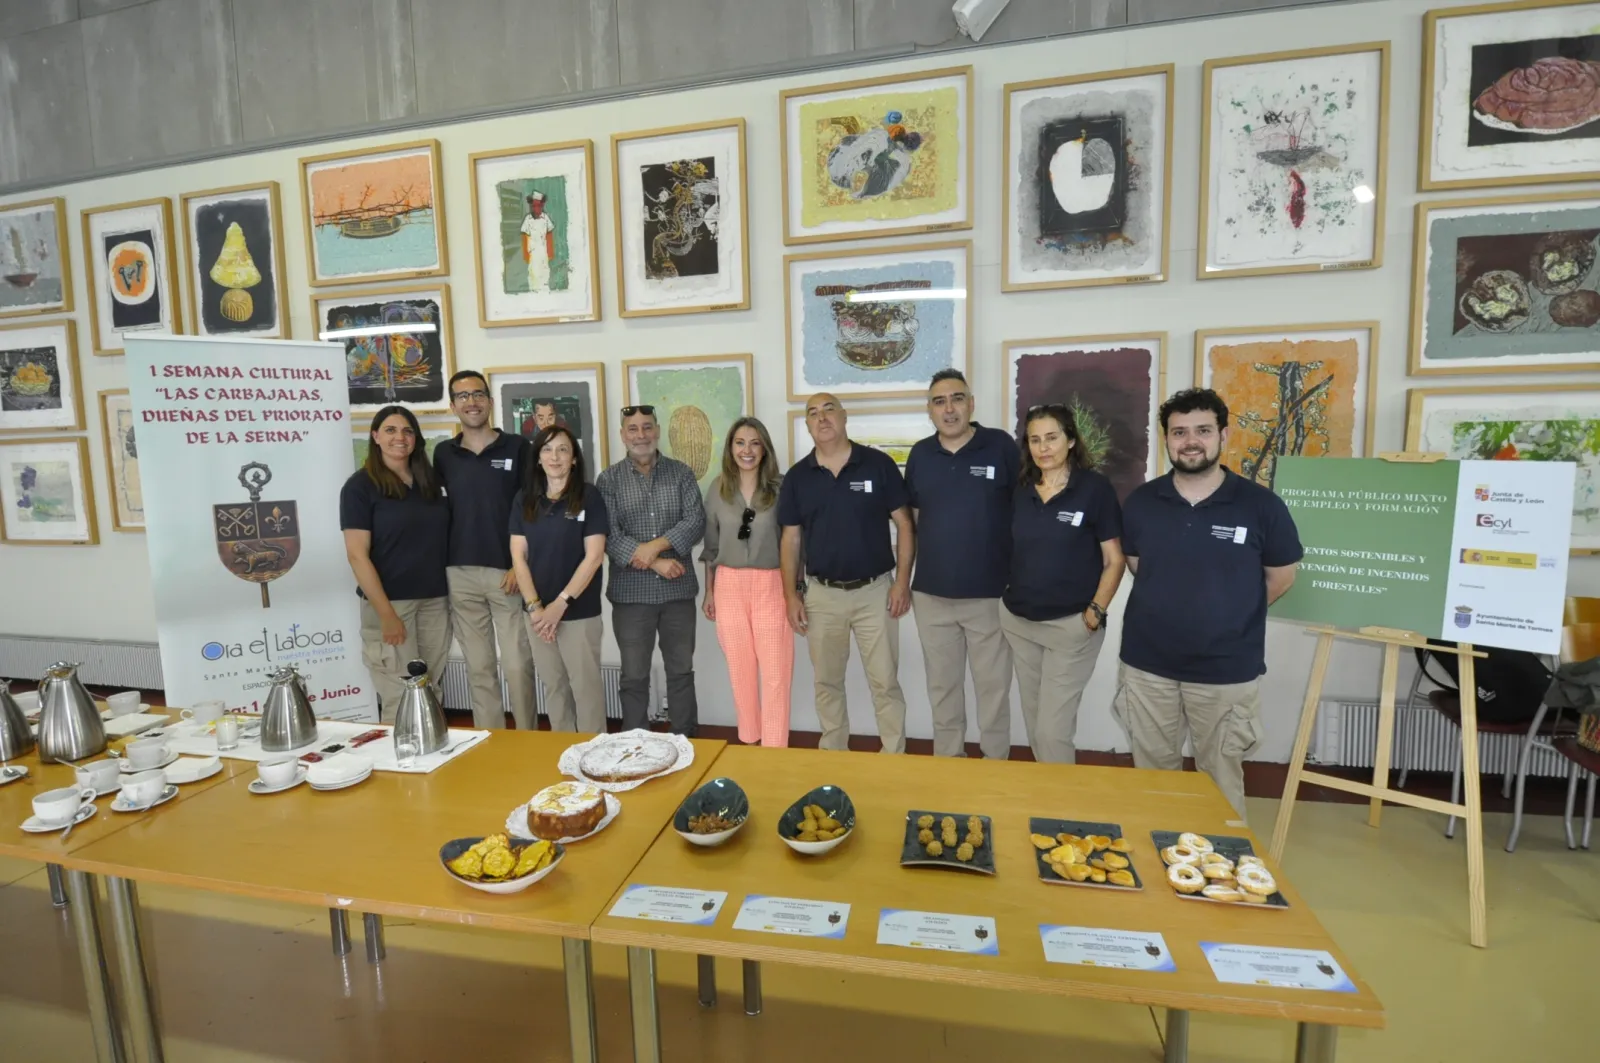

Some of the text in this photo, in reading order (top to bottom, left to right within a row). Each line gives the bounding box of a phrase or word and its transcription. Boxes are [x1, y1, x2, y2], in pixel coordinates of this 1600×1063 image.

[150, 365, 334, 381] I SEMANA CULTURAL
[142, 406, 343, 423] DUEÑAS DEL PRIORATO
[186, 431, 209, 444] DE
[216, 431, 239, 444] LA
[1281, 488, 1447, 503] PROGRAMA PÚBLICO MIXTO
[1303, 500, 1350, 509] EMPLEO
[1353, 502, 1362, 511] Y
[1365, 503, 1440, 514] FORMACIÓN
[1303, 546, 1428, 564] ENTOS SOSTENIBLES Y
[1349, 567, 1365, 576] DE
[1367, 569, 1430, 581] INCENDIOS
[204, 671, 238, 680] Santa
[246, 664, 280, 674] Marta
[306, 654, 346, 665] Tormes
[321, 685, 361, 700] Junio
